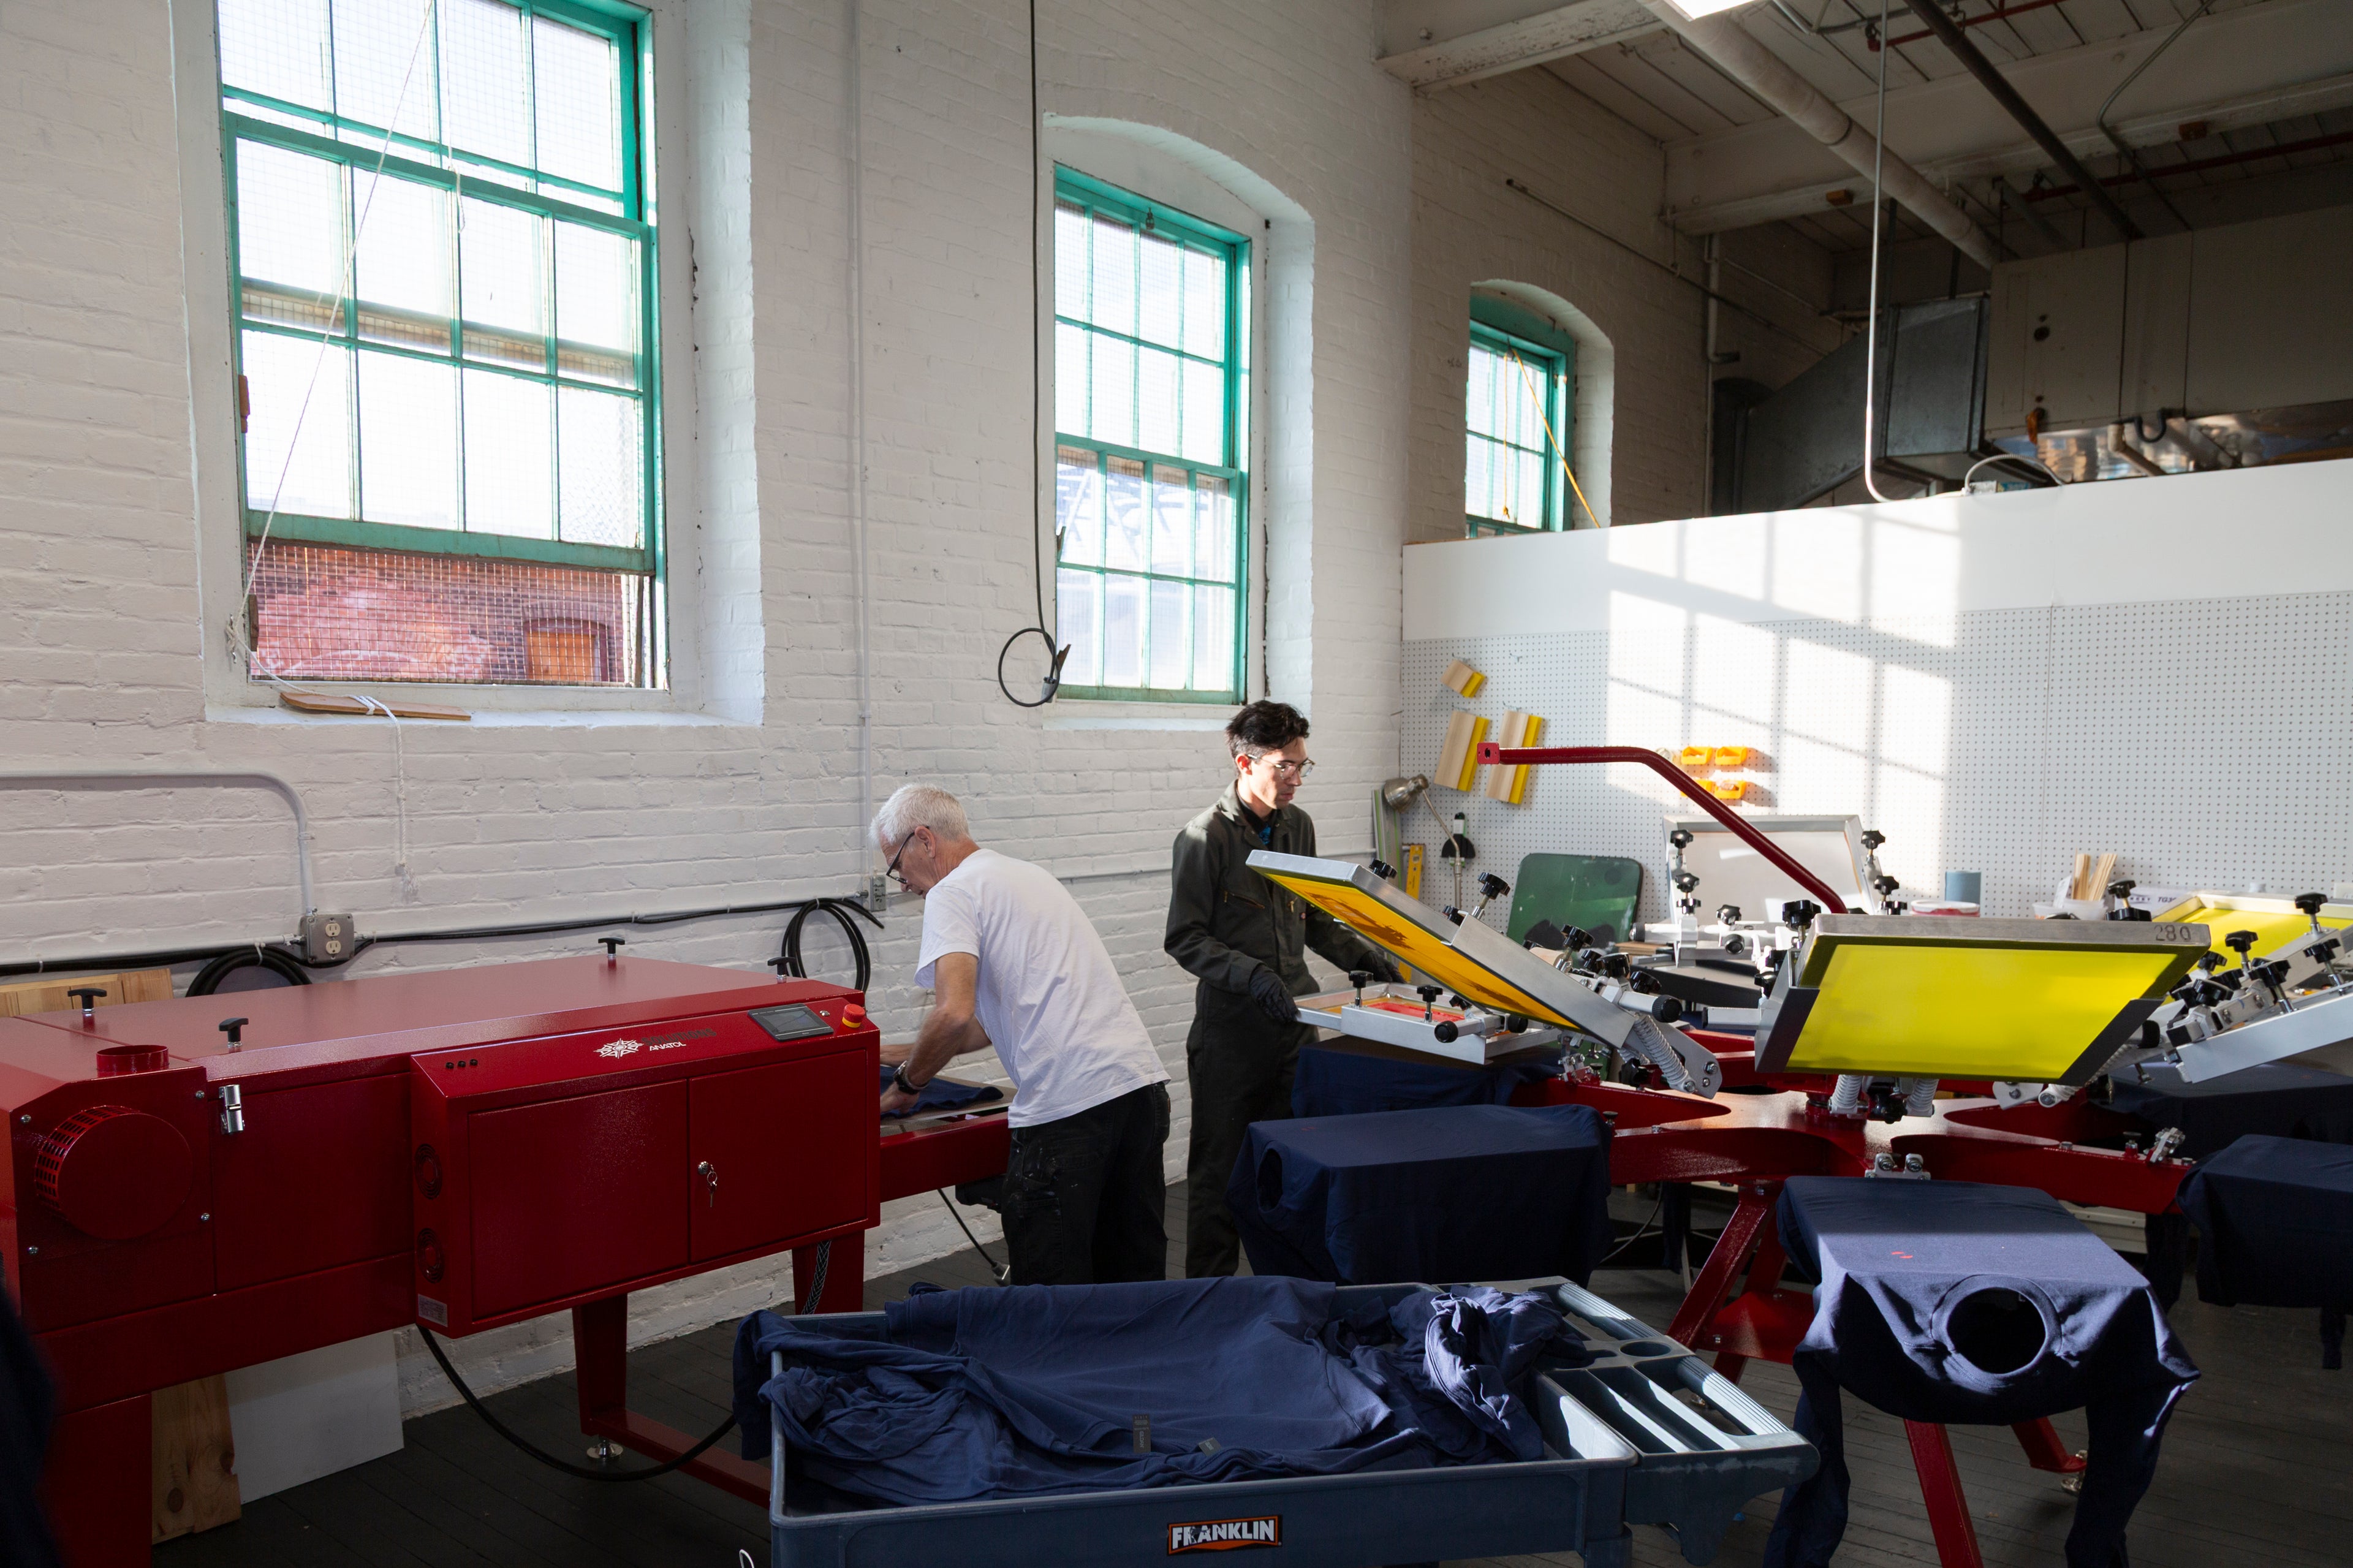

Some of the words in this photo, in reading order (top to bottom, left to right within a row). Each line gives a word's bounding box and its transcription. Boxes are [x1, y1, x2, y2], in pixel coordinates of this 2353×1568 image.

[2154, 924, 2191, 941] 280
[642, 1028, 717, 1046] SOLUTIONS
[650, 1042, 687, 1051] ANATOL
[1172, 1520, 1275, 1550] FRANKLIN
